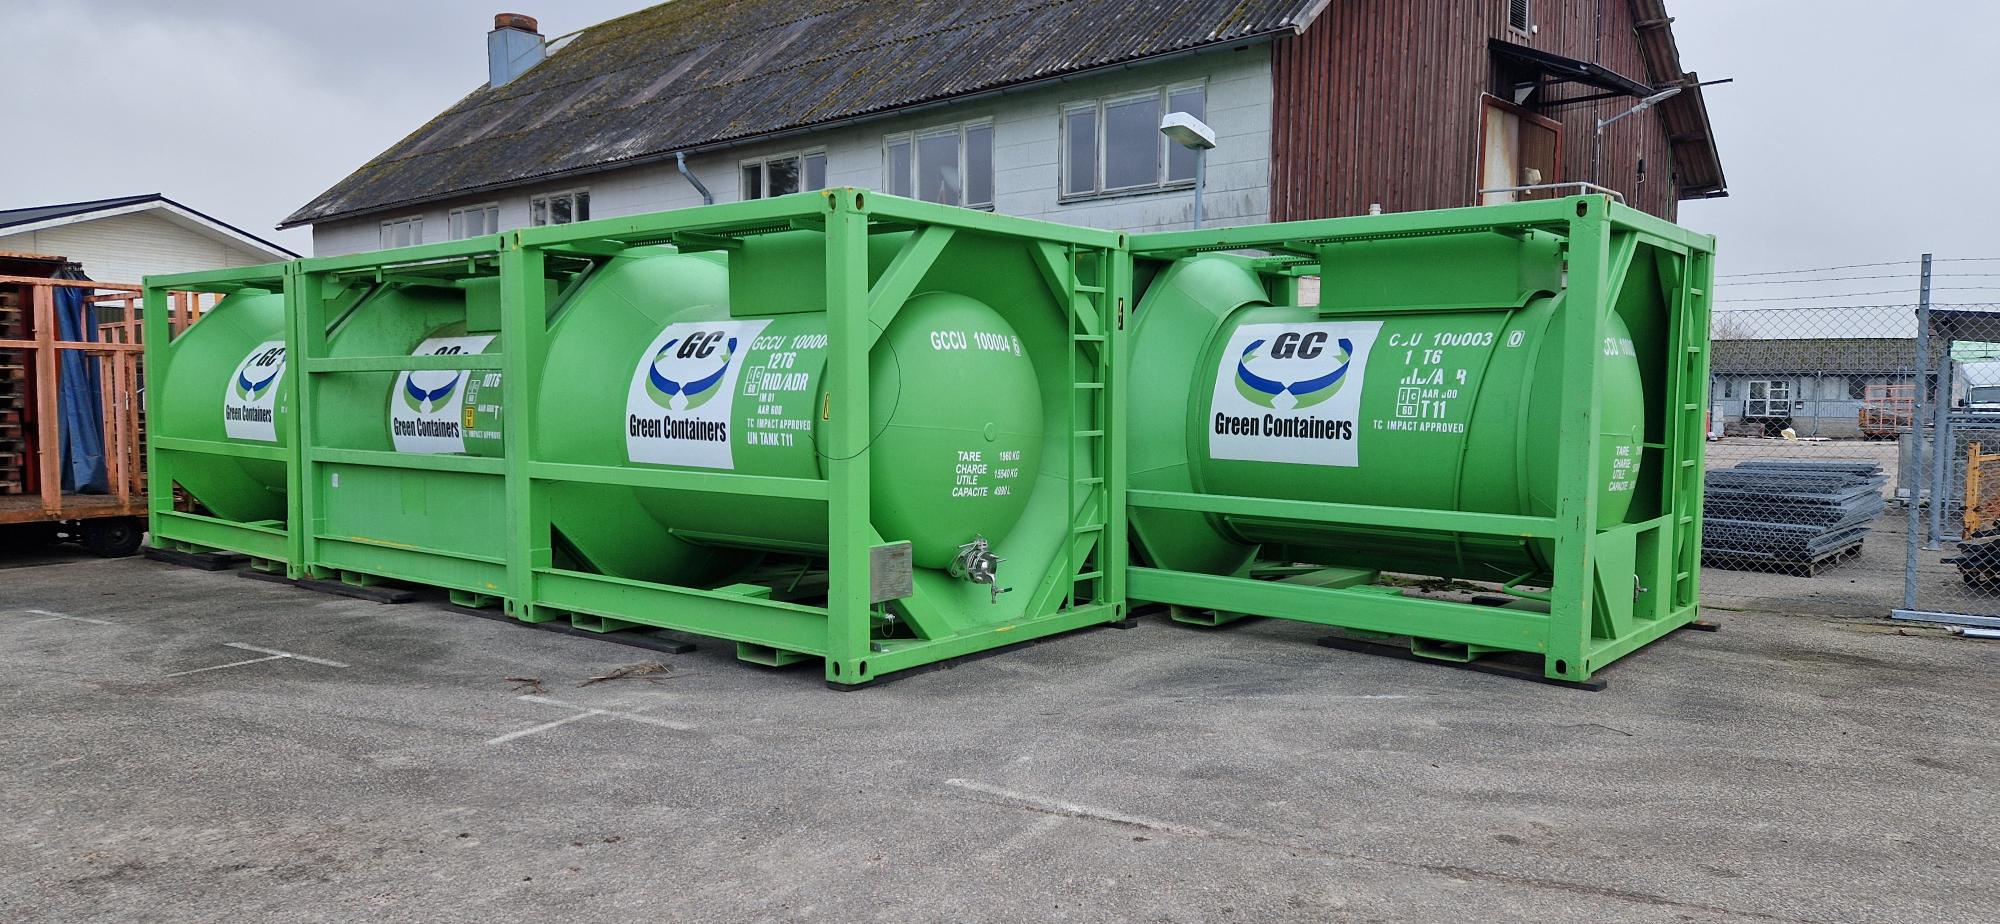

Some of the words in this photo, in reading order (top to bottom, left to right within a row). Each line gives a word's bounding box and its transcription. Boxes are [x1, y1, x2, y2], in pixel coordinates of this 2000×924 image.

[677, 330, 726, 359] GC
[752, 335, 788, 351] GCCU
[930, 330, 968, 351] GCCU
[973, 331, 1011, 353] 100004
[1270, 331, 1329, 360] GC
[1433, 332, 1494, 347] 100003
[1509, 331, 1522, 347] 0
[255, 347, 286, 367] GC
[767, 351, 797, 370] 12T6
[761, 372, 809, 391] RID/ADR
[1421, 388, 1439, 399] AAR
[225, 404, 242, 421] Green
[242, 404, 272, 424] Containers
[757, 404, 770, 415] AAR
[393, 416, 417, 437] Green
[416, 416, 460, 439] Containers
[629, 413, 662, 438] Green
[663, 415, 727, 443] Containers
[747, 417, 755, 428] TC
[756, 418, 778, 430] IMPACT
[780, 419, 811, 431] APPROVED
[1214, 411, 1260, 437] Green
[1262, 413, 1353, 441] Containers
[1373, 419, 1383, 430] TC
[1387, 420, 1417, 432] IMPACT
[1419, 421, 1464, 433] APPROVED
[747, 431, 758, 445] UN
[759, 431, 780, 446] TANK
[780, 432, 793, 447] T11
[957, 450, 982, 462] TARE
[955, 463, 988, 474] CHARGE
[956, 474, 979, 485] UTILE
[952, 486, 989, 497] CAPACITE
